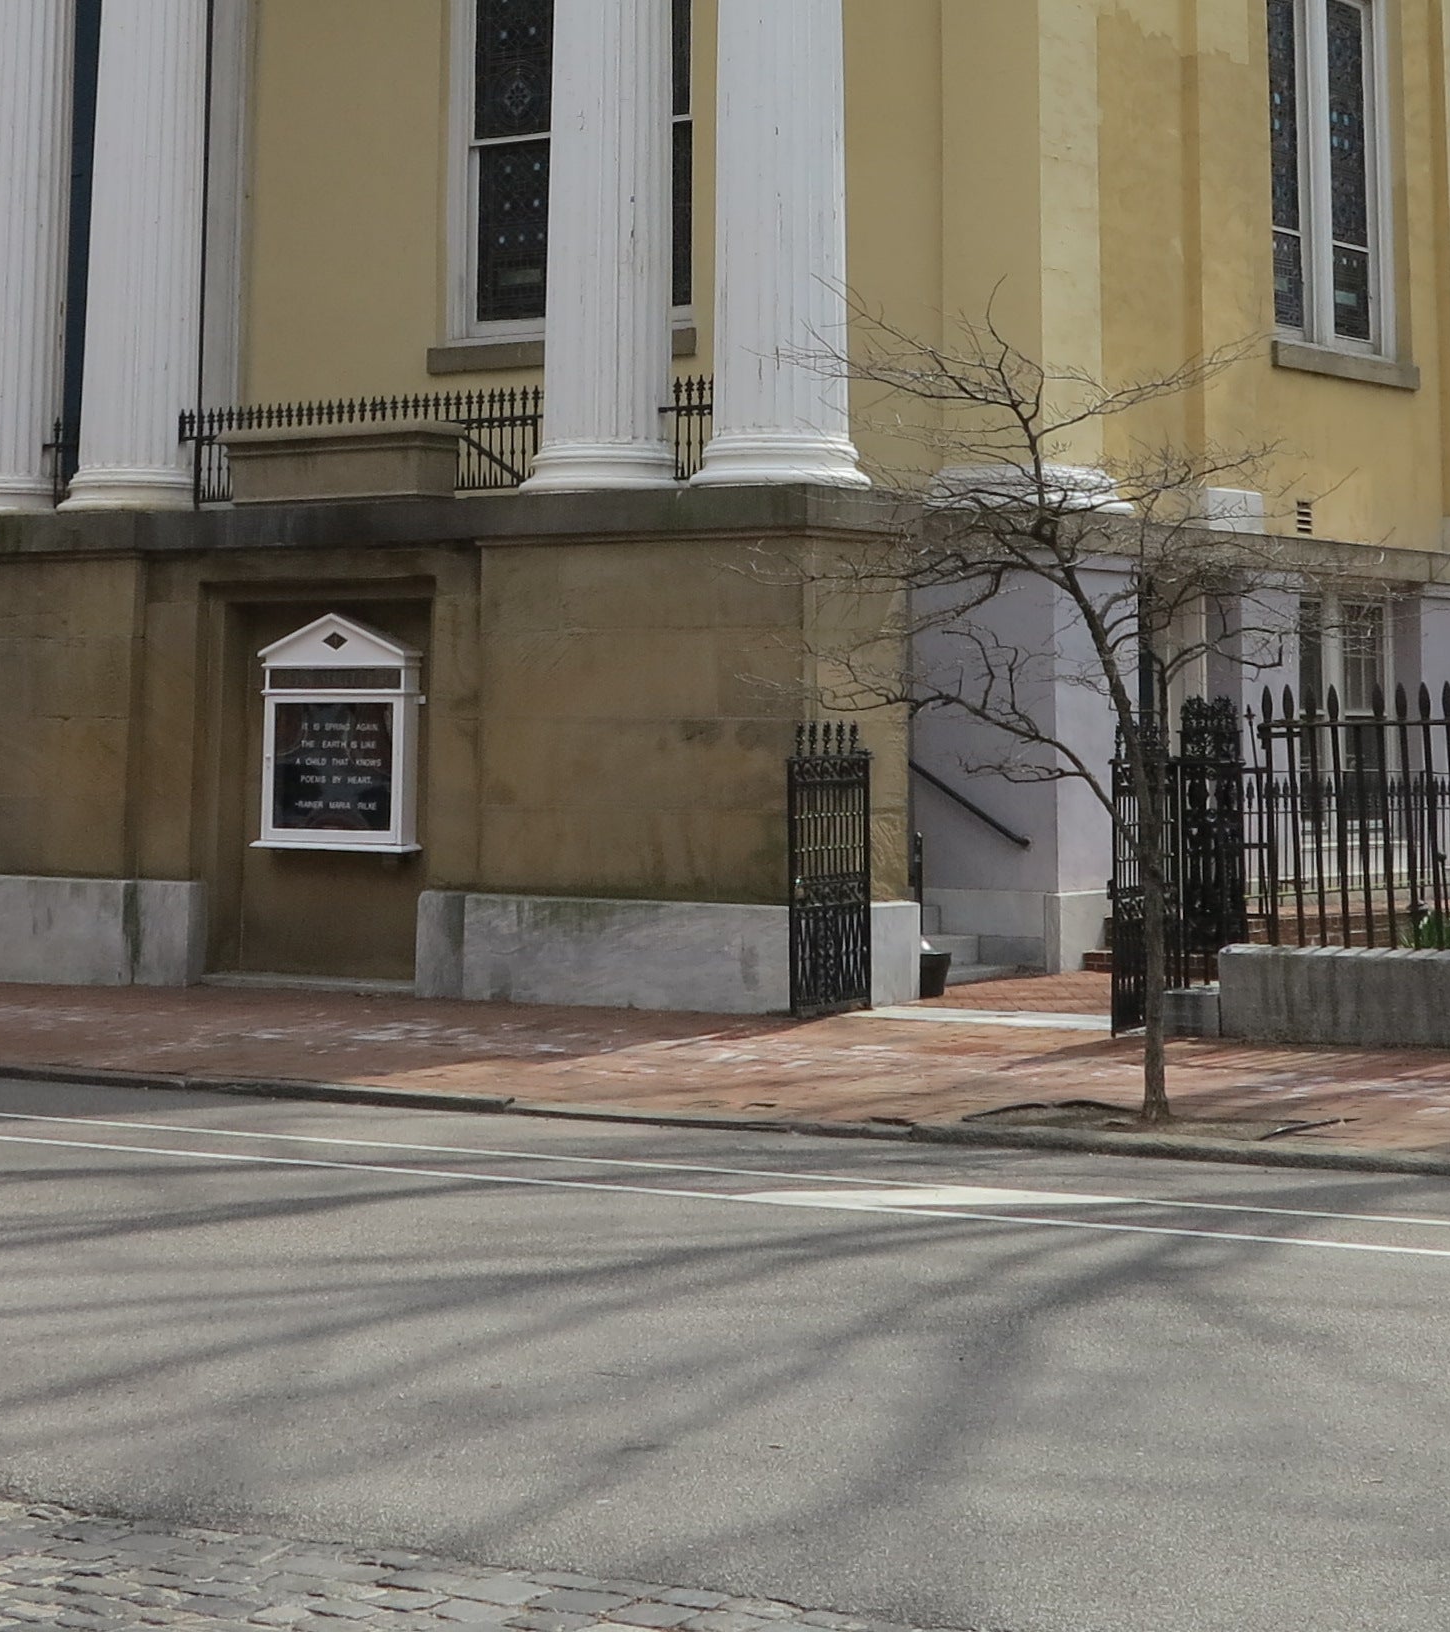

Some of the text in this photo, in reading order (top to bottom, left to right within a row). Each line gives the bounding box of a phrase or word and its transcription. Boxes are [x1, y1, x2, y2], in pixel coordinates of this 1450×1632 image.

[301, 740, 377, 749] THE EARTH IS LIKE
[305, 757, 327, 766] CHILD
[331, 757, 349, 766] THAT
[355, 758, 382, 767] KNOWS
[300, 775, 327, 784] POEMS
[332, 775, 342, 784] BY
[329, 801, 351, 809] MARIA
[357, 801, 377, 811] RILKE
